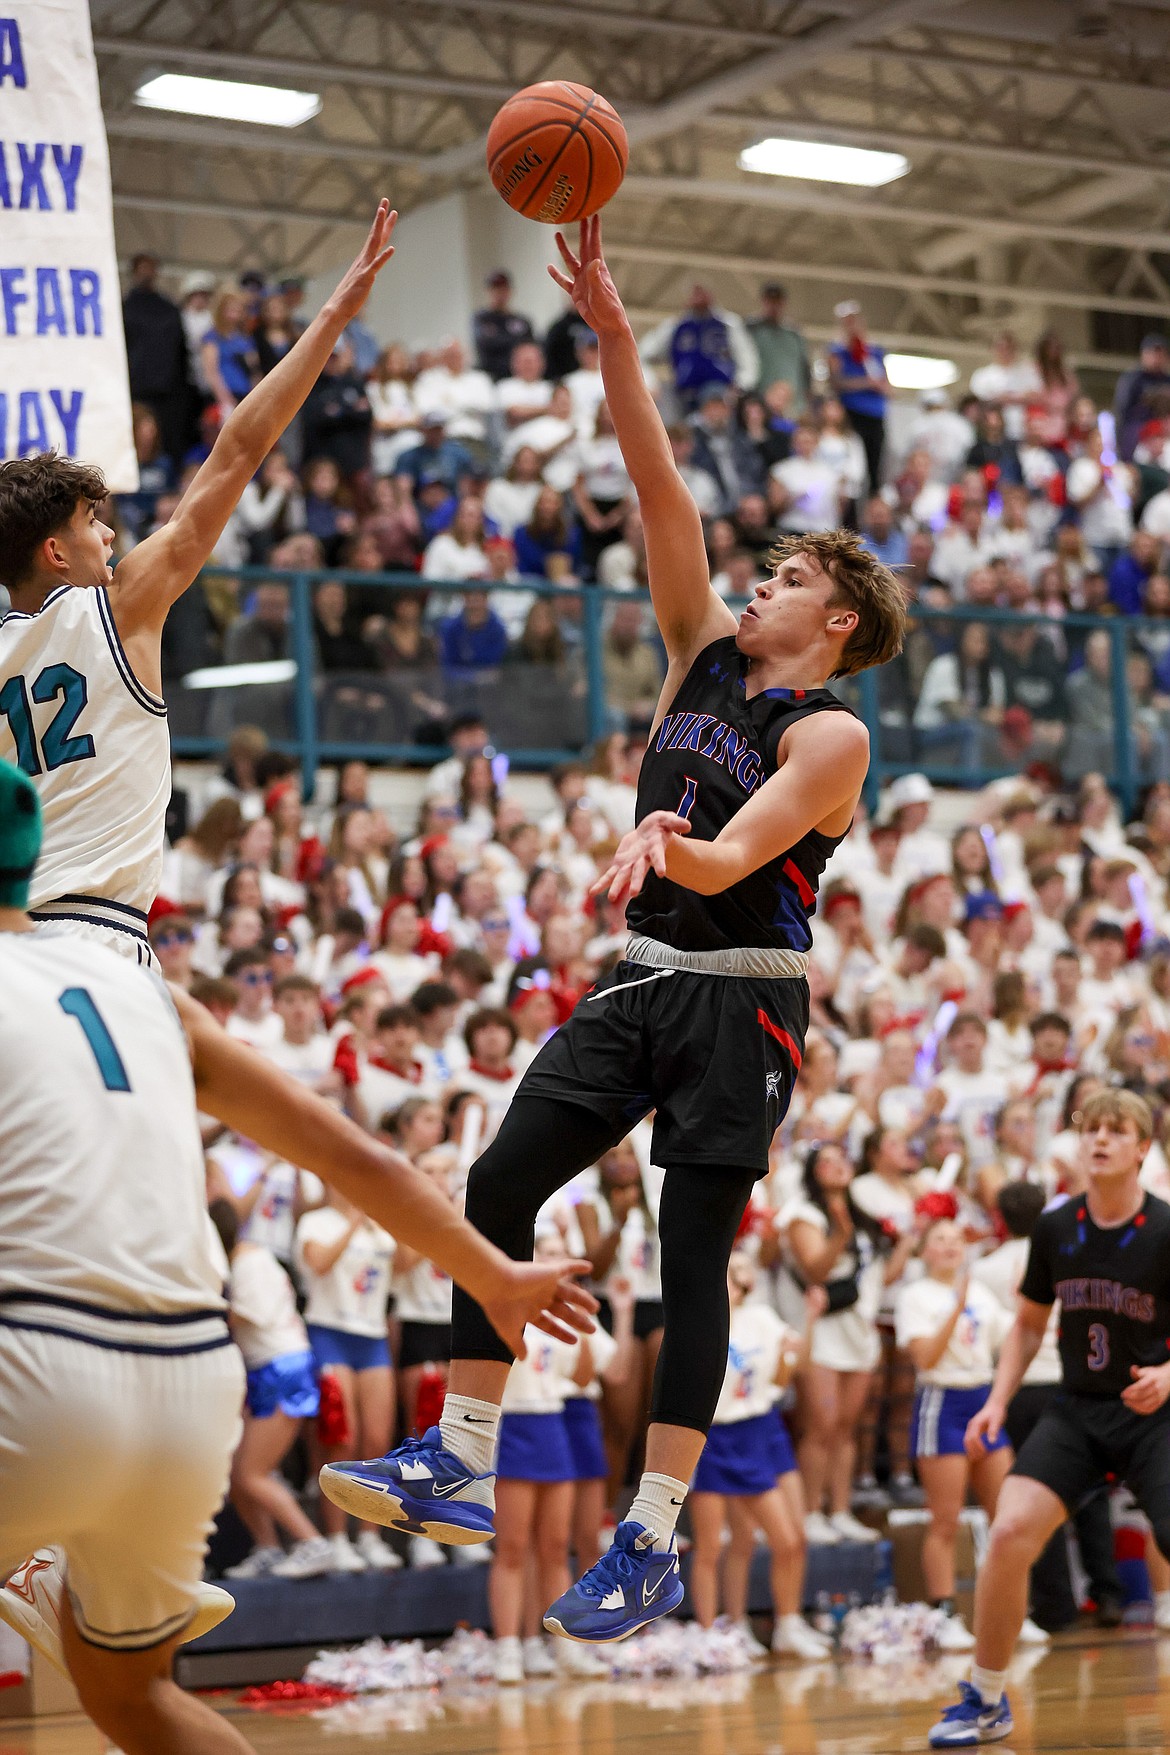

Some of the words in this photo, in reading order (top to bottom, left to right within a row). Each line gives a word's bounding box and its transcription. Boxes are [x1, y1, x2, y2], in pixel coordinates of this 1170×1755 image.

[0, 18, 27, 89] A
[0, 268, 103, 336] FAR
[0, 389, 83, 458] AY
[0, 662, 96, 777] 12
[58, 987, 132, 1092] 1
[1087, 1322, 1110, 1372] 3
